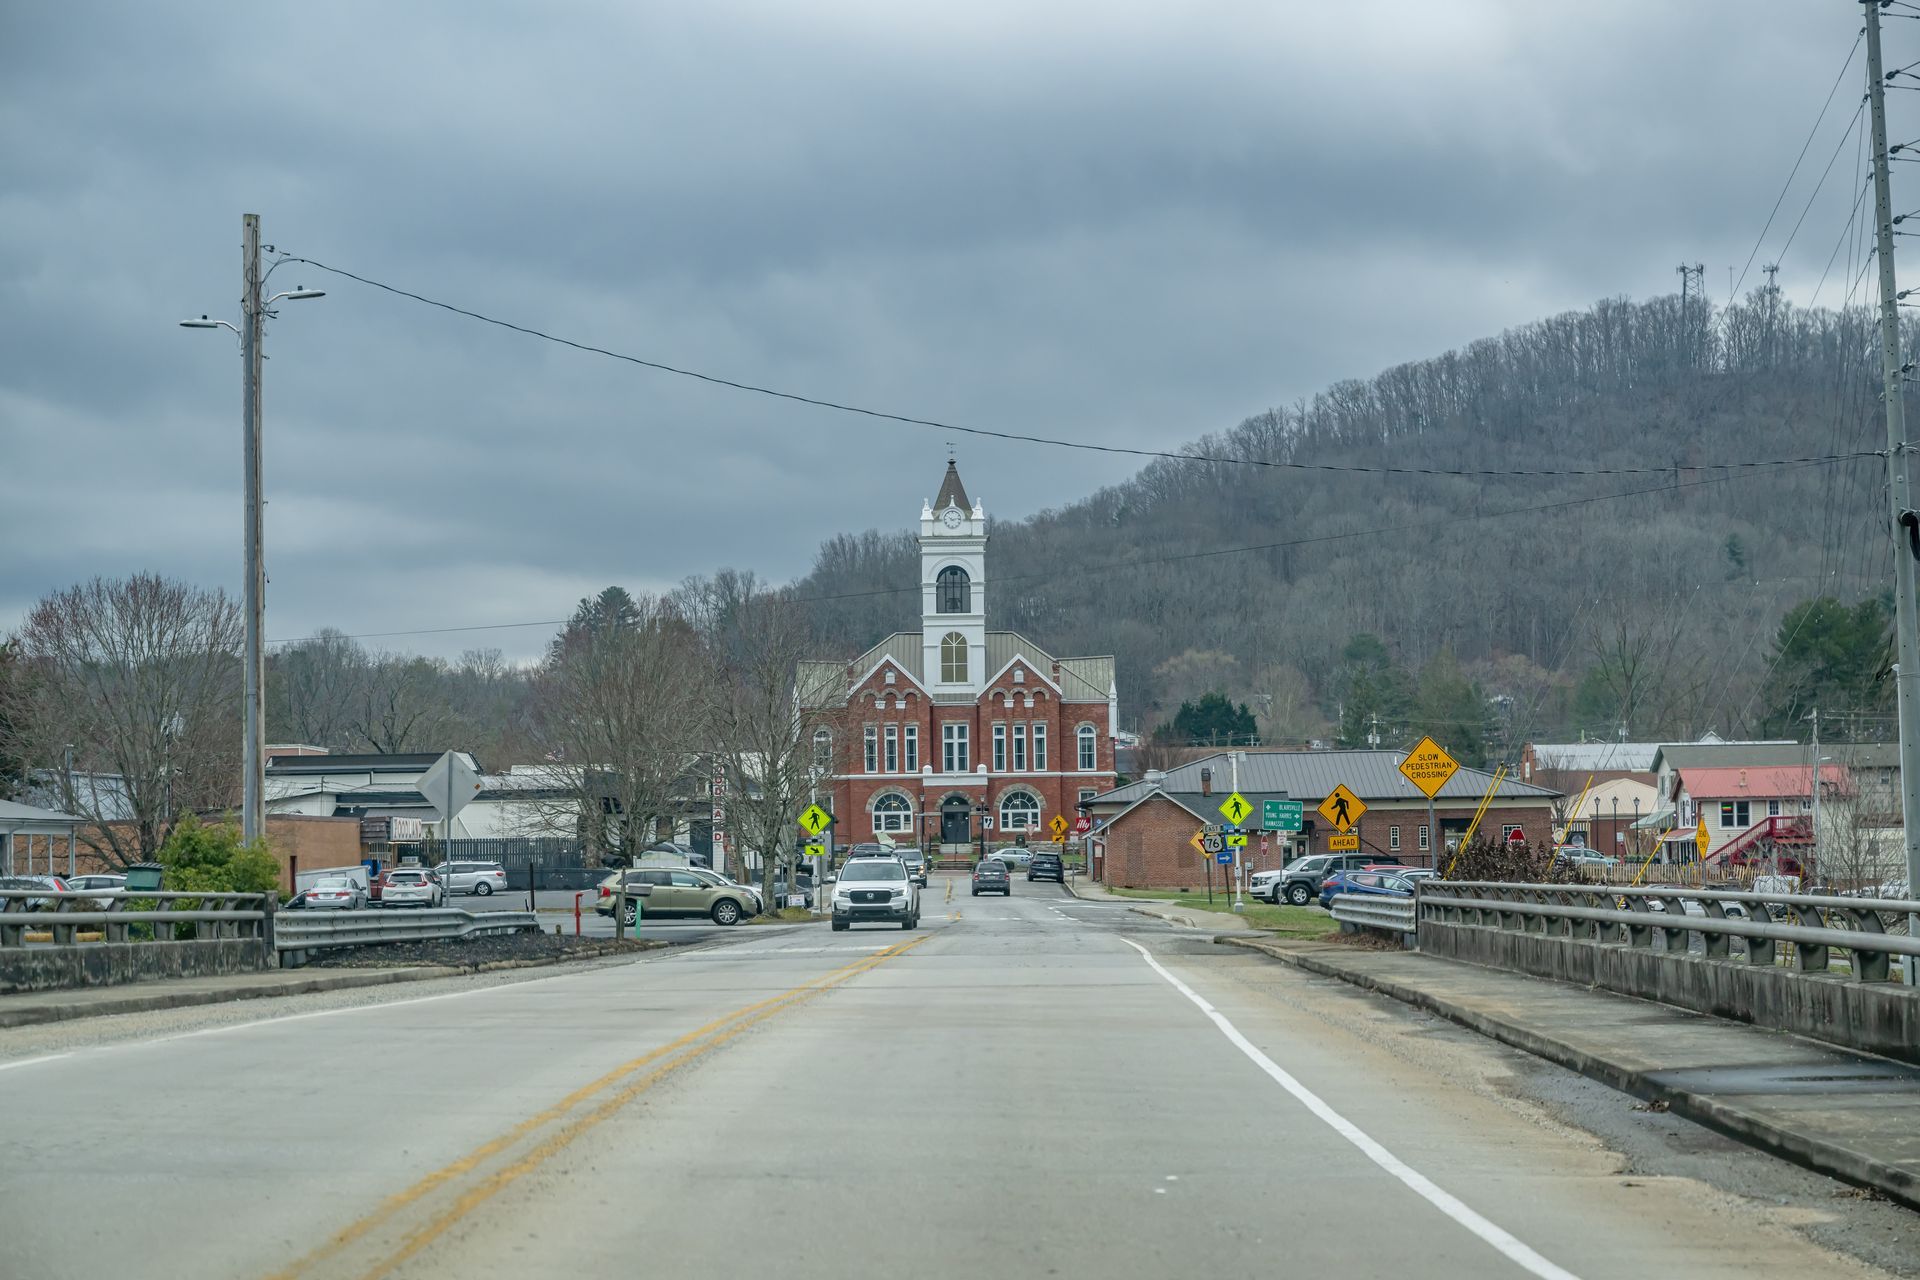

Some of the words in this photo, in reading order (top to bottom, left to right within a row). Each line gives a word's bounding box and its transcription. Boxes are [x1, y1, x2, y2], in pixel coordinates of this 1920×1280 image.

[1406, 762, 1452, 770] PEDESTRIAN
[1412, 770, 1448, 778] CROSSING
[1076, 819, 1090, 830] illy
[1206, 839, 1219, 848] 76
